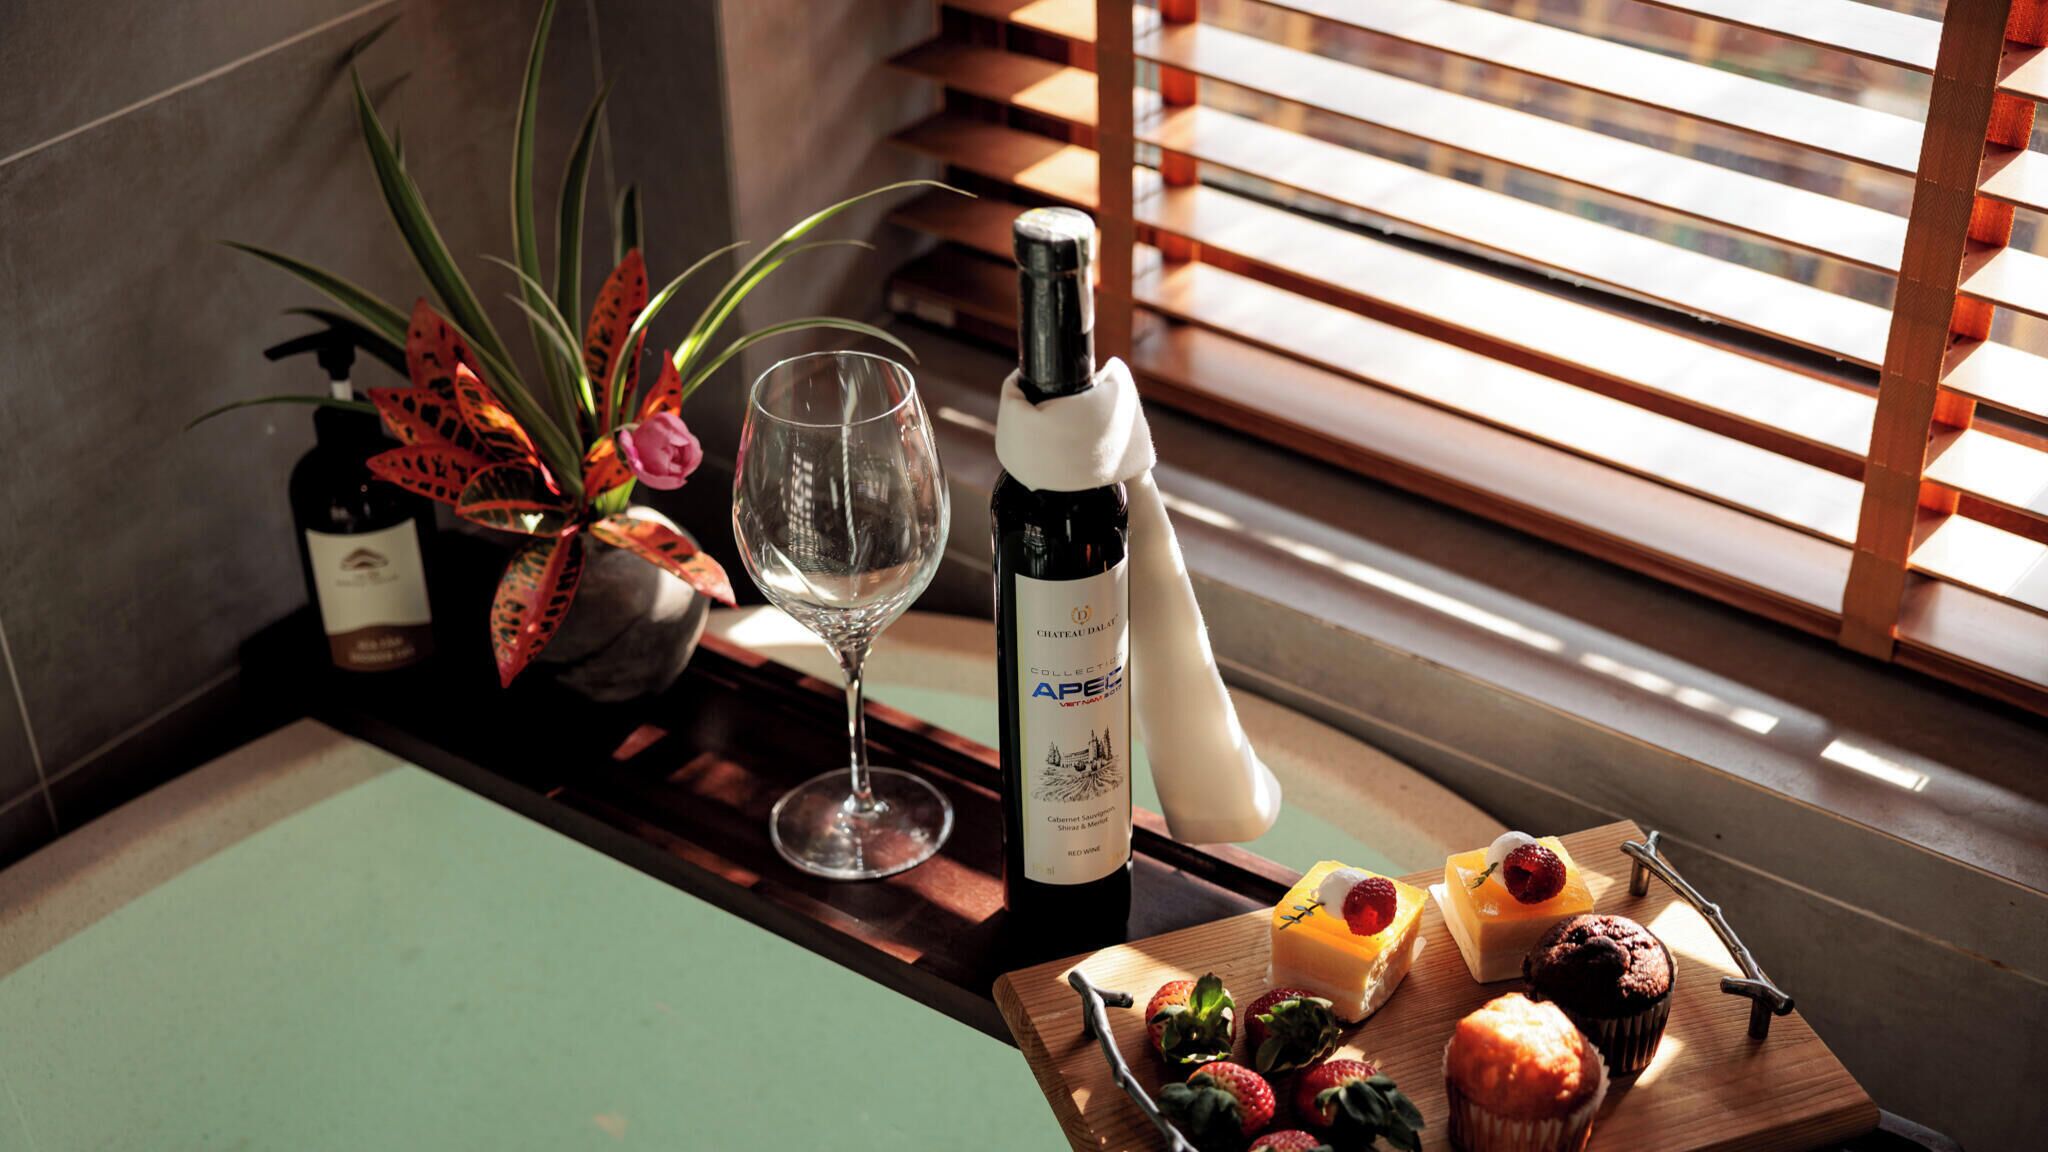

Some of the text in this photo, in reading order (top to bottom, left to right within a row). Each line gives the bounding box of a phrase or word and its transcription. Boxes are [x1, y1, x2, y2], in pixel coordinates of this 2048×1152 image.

[1036, 618, 1115, 639] CHATEAU DALAT
[1031, 665, 1122, 700] APEC
[1047, 815, 1080, 823] Cabernet
[1057, 823, 1079, 832] Shiraz
[1087, 816, 1109, 828] Merlot
[1067, 849, 1083, 857] RED
[1083, 845, 1101, 855] WINE
